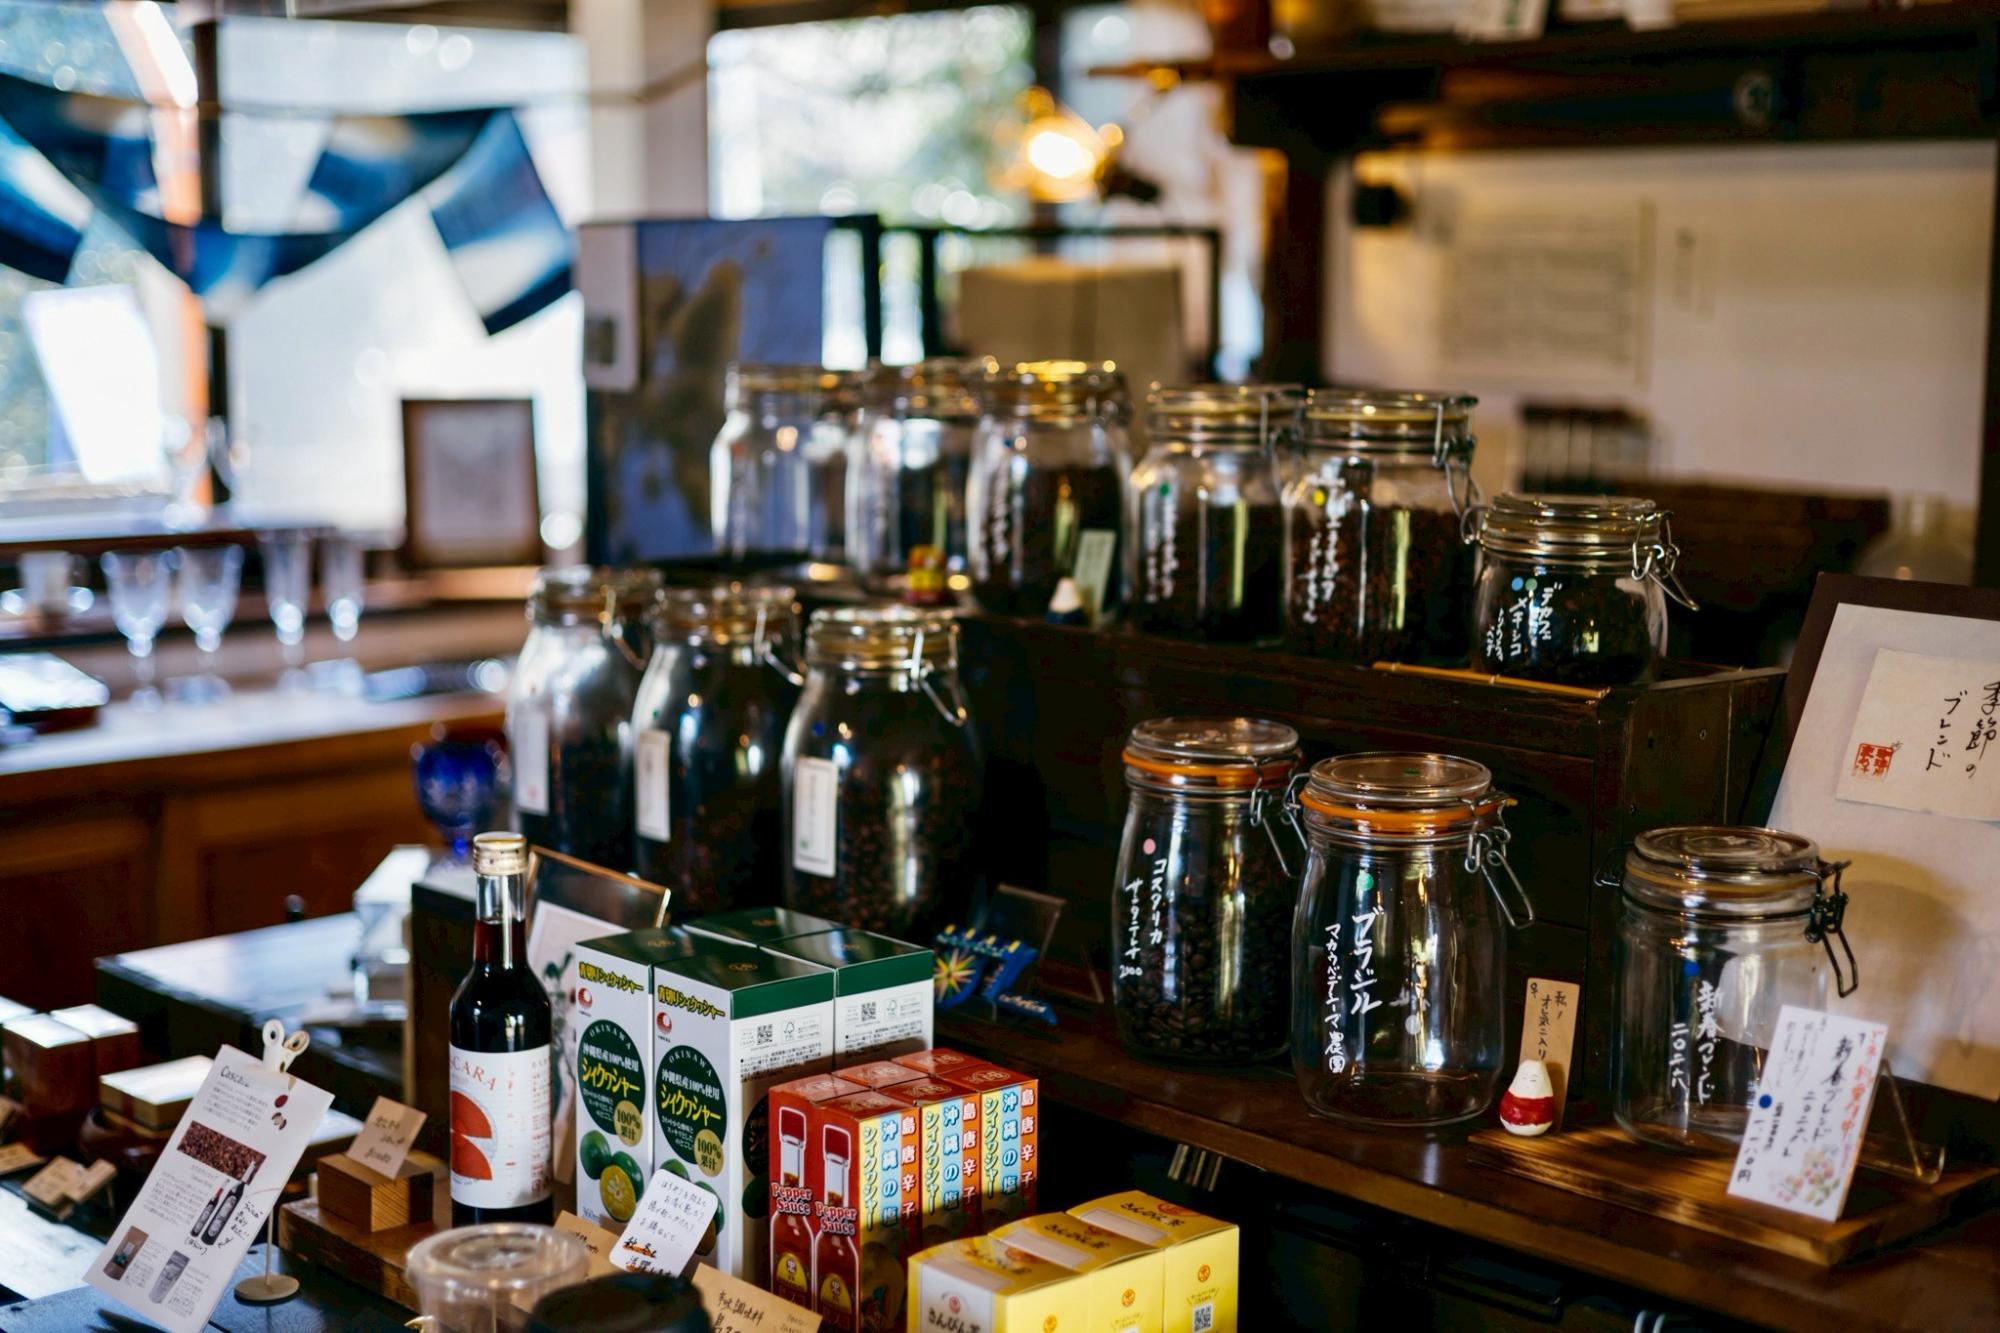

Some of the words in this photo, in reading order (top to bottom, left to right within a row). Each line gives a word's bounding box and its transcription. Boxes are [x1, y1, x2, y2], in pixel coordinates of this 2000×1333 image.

[1508, 596, 1528, 657] メキシコ
[1538, 581, 1563, 641] デカフェ
[1925, 690, 1969, 772] ブレンド
[1149, 859, 1167, 945] コスタリカ
[1350, 905, 1385, 1015] ブラジル
[588, 1022, 632, 1052] OKINAWA
[668, 1048, 713, 1078] OKINAWA
[1696, 979, 1725, 1105] 新春ブレンド
[616, 1108, 641, 1131] 100%
[619, 1124, 637, 1142] 果汁
[696, 1137, 721, 1160] 100%
[1002, 1091, 1019, 1195] 沖縄の塩
[1021, 1088, 1035, 1189] 島唐辛子
[700, 1154, 717, 1172] 果汁
[881, 1120, 899, 1226] 沖縄の塩
[901, 1115, 916, 1220] 島唐辛子
[943, 1105, 960, 1211] 沖縄の塩
[962, 1101, 977, 1205] 島唐辛子
[770, 1182, 814, 1202] Pepper
[775, 1198, 811, 1216] Sauce
[814, 1199, 857, 1222] Pepper
[820, 1216, 856, 1236] Sauce
